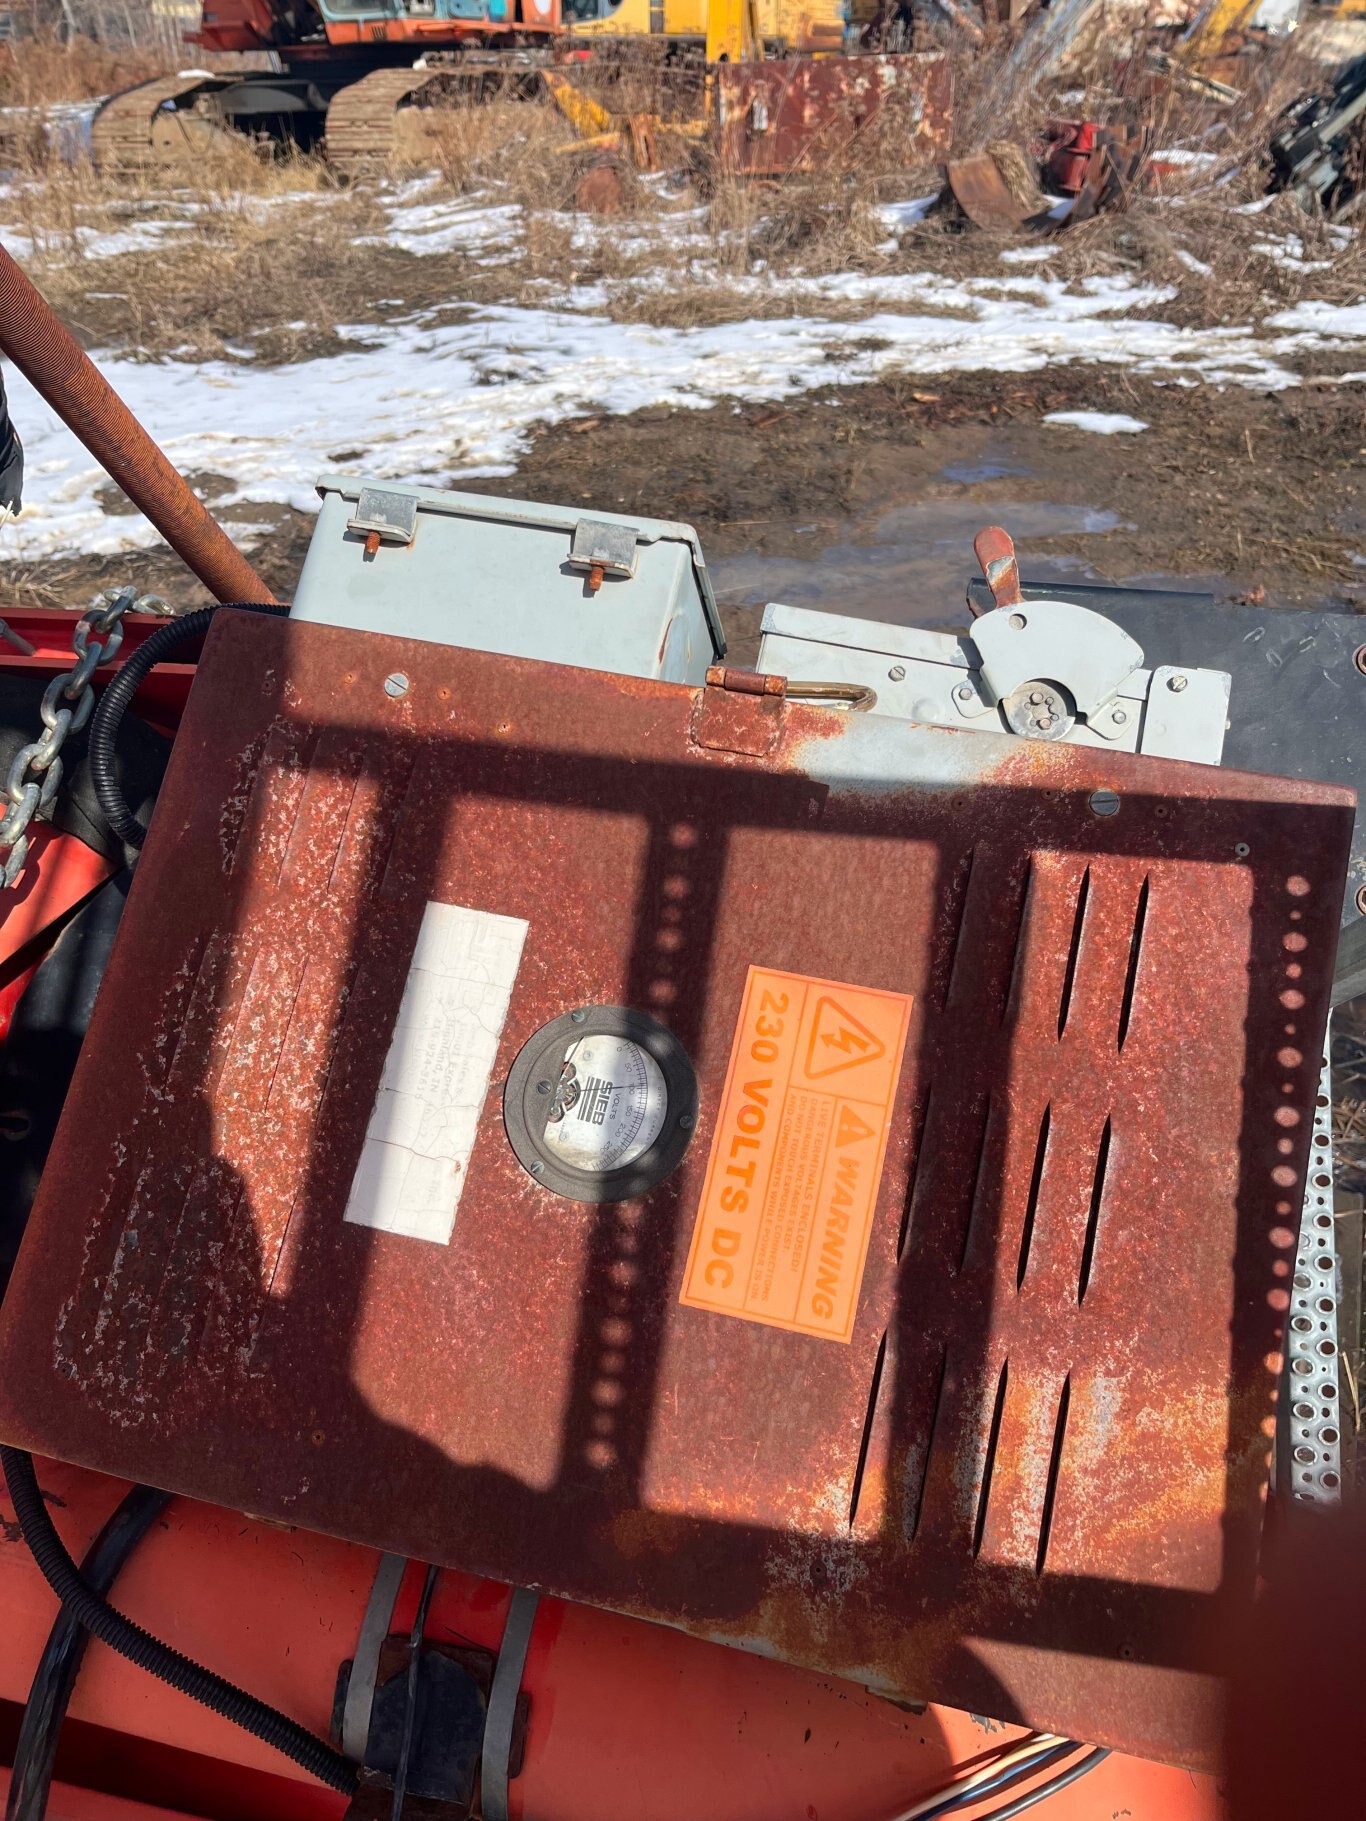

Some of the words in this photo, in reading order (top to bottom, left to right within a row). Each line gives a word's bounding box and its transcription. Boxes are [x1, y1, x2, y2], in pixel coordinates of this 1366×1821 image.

[749, 988, 789, 1063] 230
[429, 1078, 439, 1092] IN
[624, 1063, 632, 1073] 50
[592, 1081, 613, 1125] SIEB
[628, 1082, 636, 1095] 100
[786, 1093, 796, 1116] AND
[798, 1095, 808, 1111] DO
[609, 1094, 620, 1119] VOLTS
[625, 1105, 633, 1117] 150
[794, 1112, 804, 1134] NOT
[816, 1100, 831, 1128] LIVE
[614, 1123, 626, 1138] 200
[719, 1077, 773, 1213] VOLTS
[799, 1097, 818, 1160] DANGEROUS
[772, 1117, 791, 1187] COMPONENTS
[786, 1137, 799, 1172] TOUCH
[803, 1132, 824, 1200] TERMINALS
[765, 1190, 777, 1224] WHILE
[776, 1174, 792, 1222] EXPOSED
[788, 1163, 805, 1216] VOLTAGES
[756, 1227, 770, 1266] POWER
[790, 1203, 810, 1273] ENCLOSED!
[810, 1155, 860, 1319] WARNING
[703, 1226, 742, 1289] DC
[753, 1268, 763, 1281] IS
